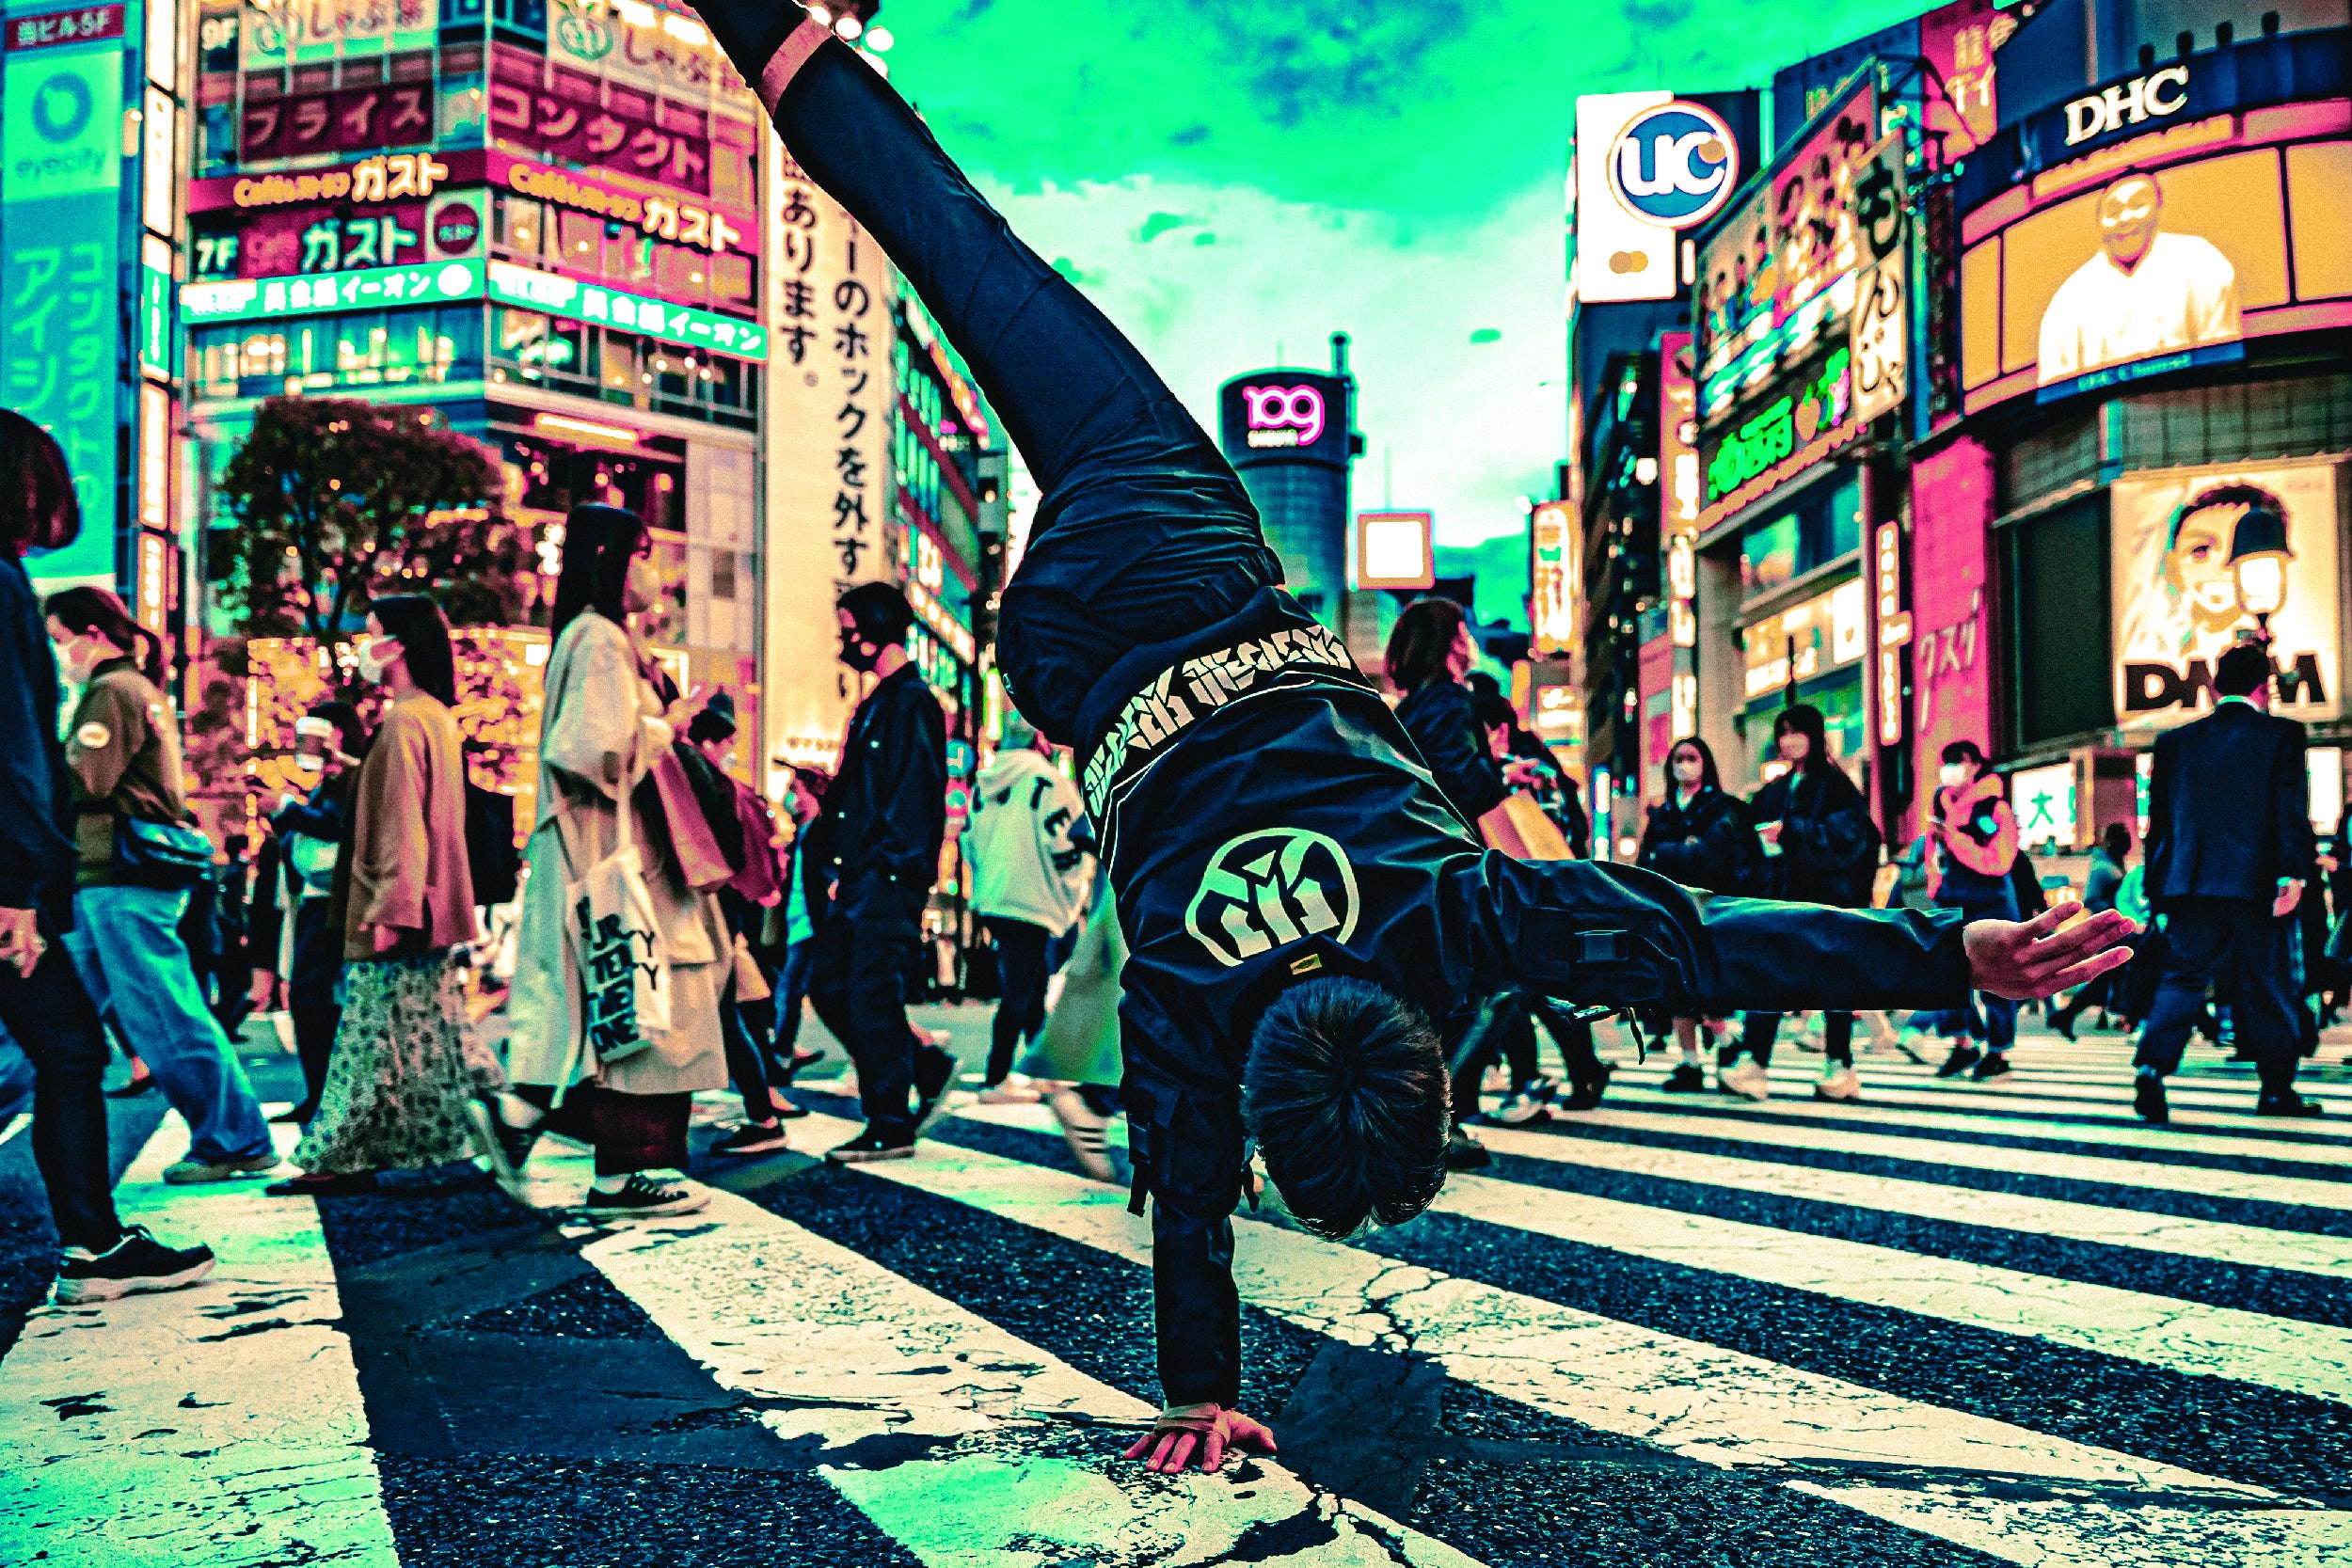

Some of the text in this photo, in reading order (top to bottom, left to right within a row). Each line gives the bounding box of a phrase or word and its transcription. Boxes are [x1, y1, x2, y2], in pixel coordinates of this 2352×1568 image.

[491, 85, 706, 178] コンタクト
[2064, 65, 2188, 147] DHC
[196, 237, 239, 273] 7F
[302, 215, 418, 273] ガスト
[1242, 384, 1325, 446] 109
